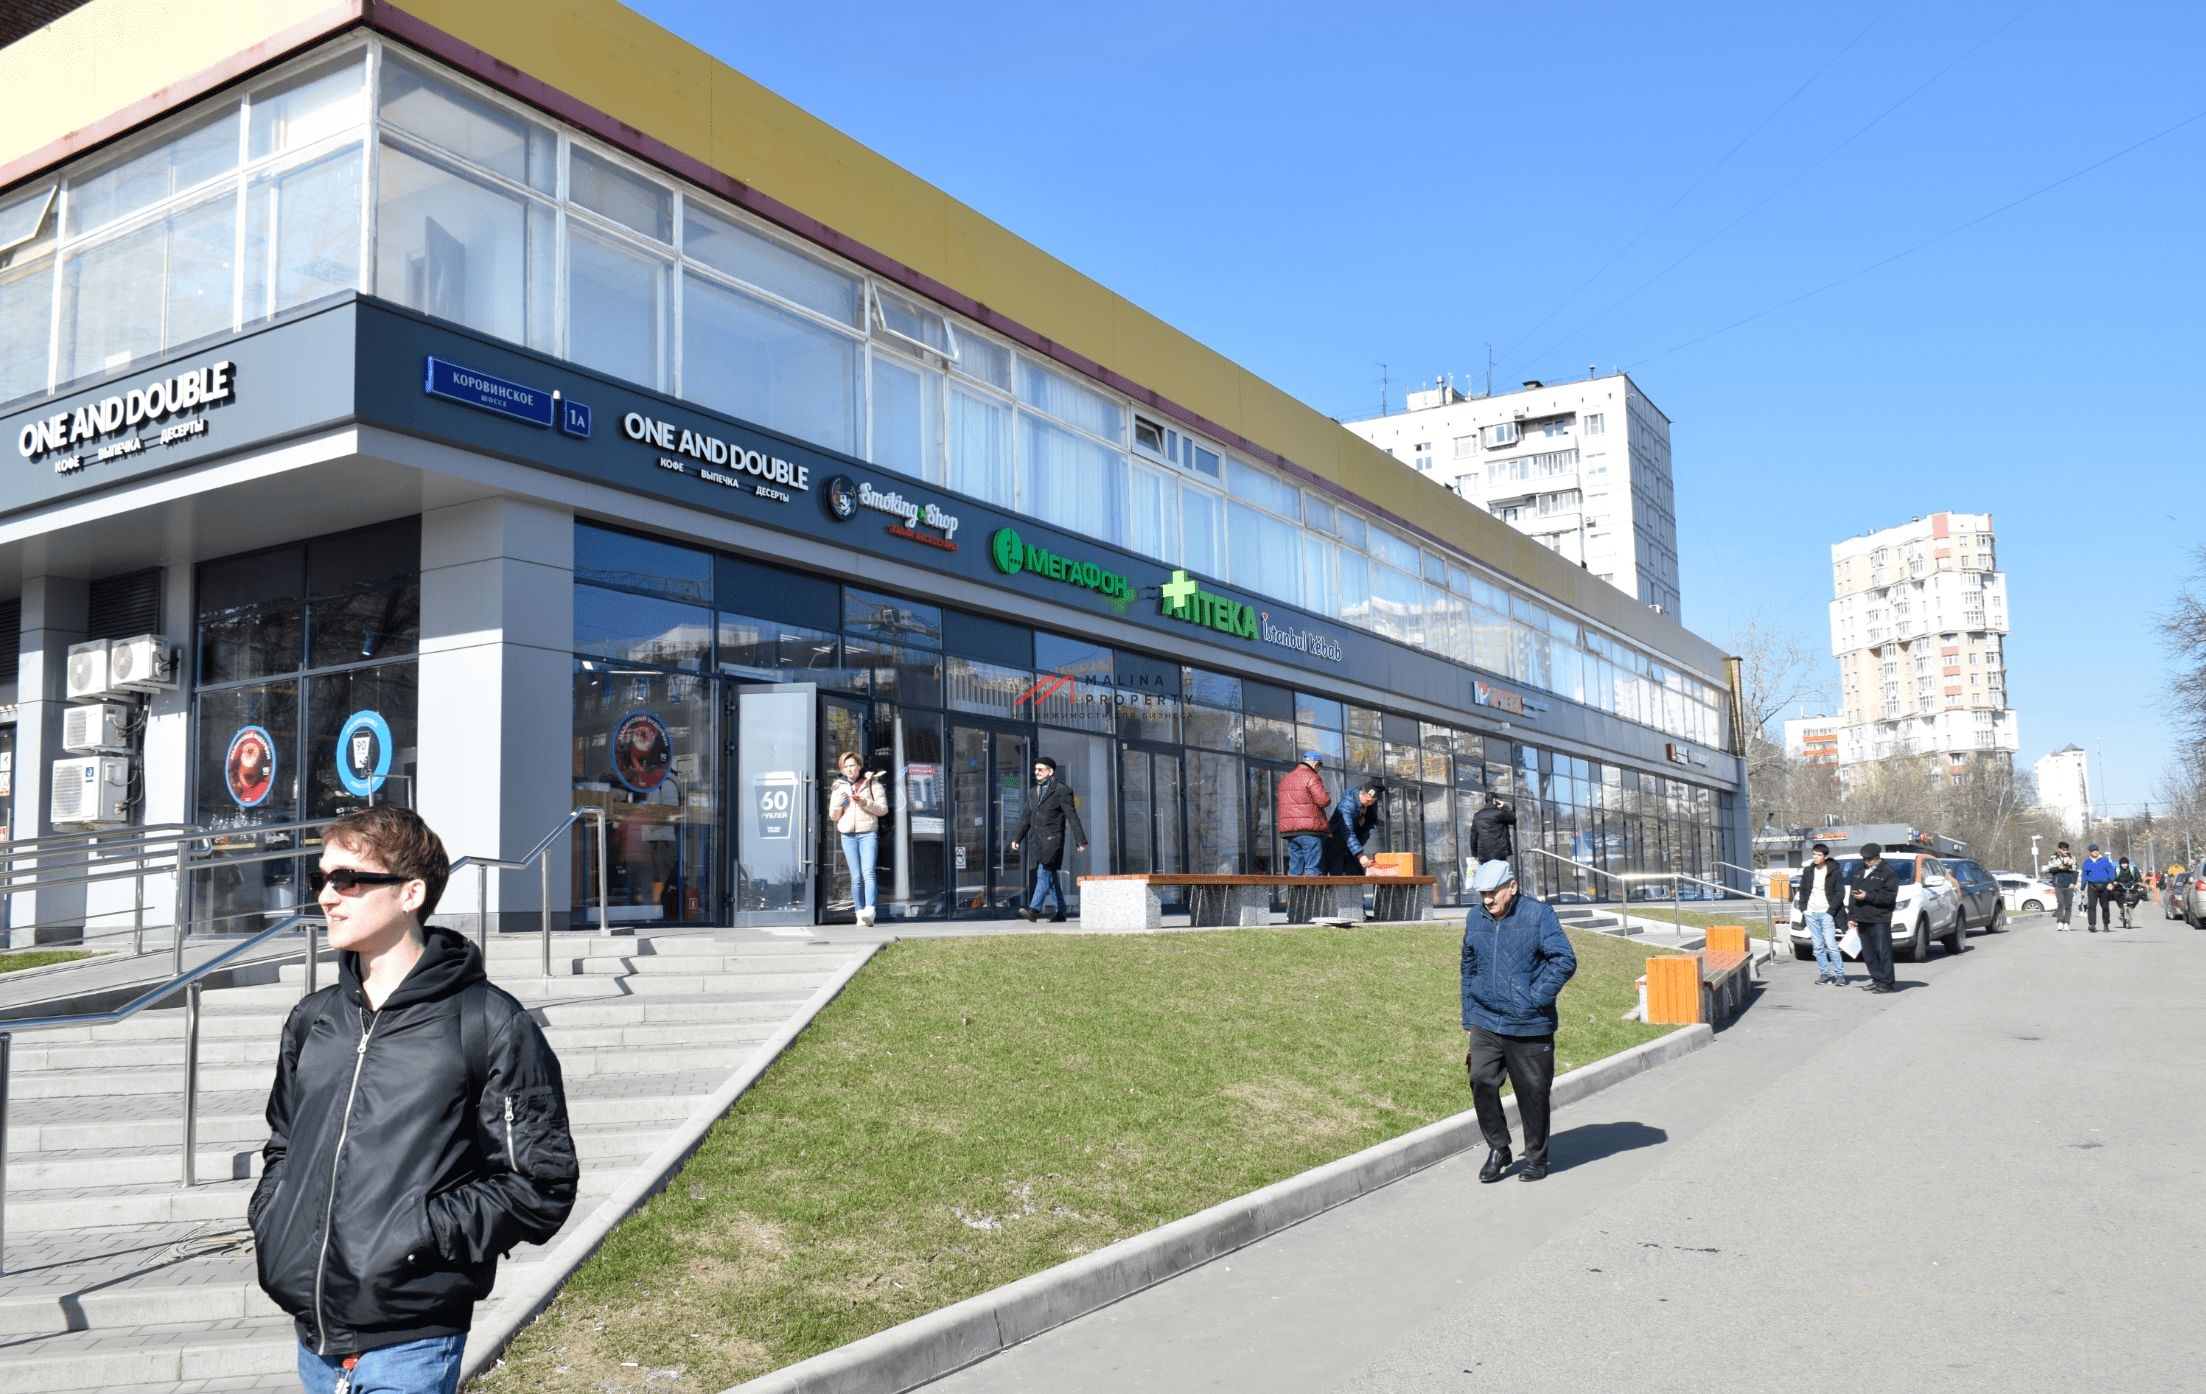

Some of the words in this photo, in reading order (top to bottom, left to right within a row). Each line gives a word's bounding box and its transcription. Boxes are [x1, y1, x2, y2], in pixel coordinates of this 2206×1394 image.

[18, 412, 69, 458] ONE
[69, 395, 124, 442] AND
[126, 360, 229, 426] DOUBLE
[453, 371, 535, 406] КОРОВИНСКОЕ
[570, 409, 585, 429] 1А
[54, 455, 80, 474] КОФЕ
[97, 438, 142, 461] ВЫПЕЧКА
[159, 418, 205, 445] ДЕСЕРТЫ
[624, 411, 676, 451] ONE
[678, 429, 728, 465] AND
[730, 443, 809, 491] DOUBLE
[660, 457, 684, 473] КОФЕ
[700, 468, 739, 489] ВЫПЕЧКА
[756, 485, 790, 503] ДЕСЕРТЫ
[858, 482, 919, 529] Smoking
[925, 503, 959, 540] Shop
[356, 740, 367, 751] 90
[760, 790, 789, 811] 60
